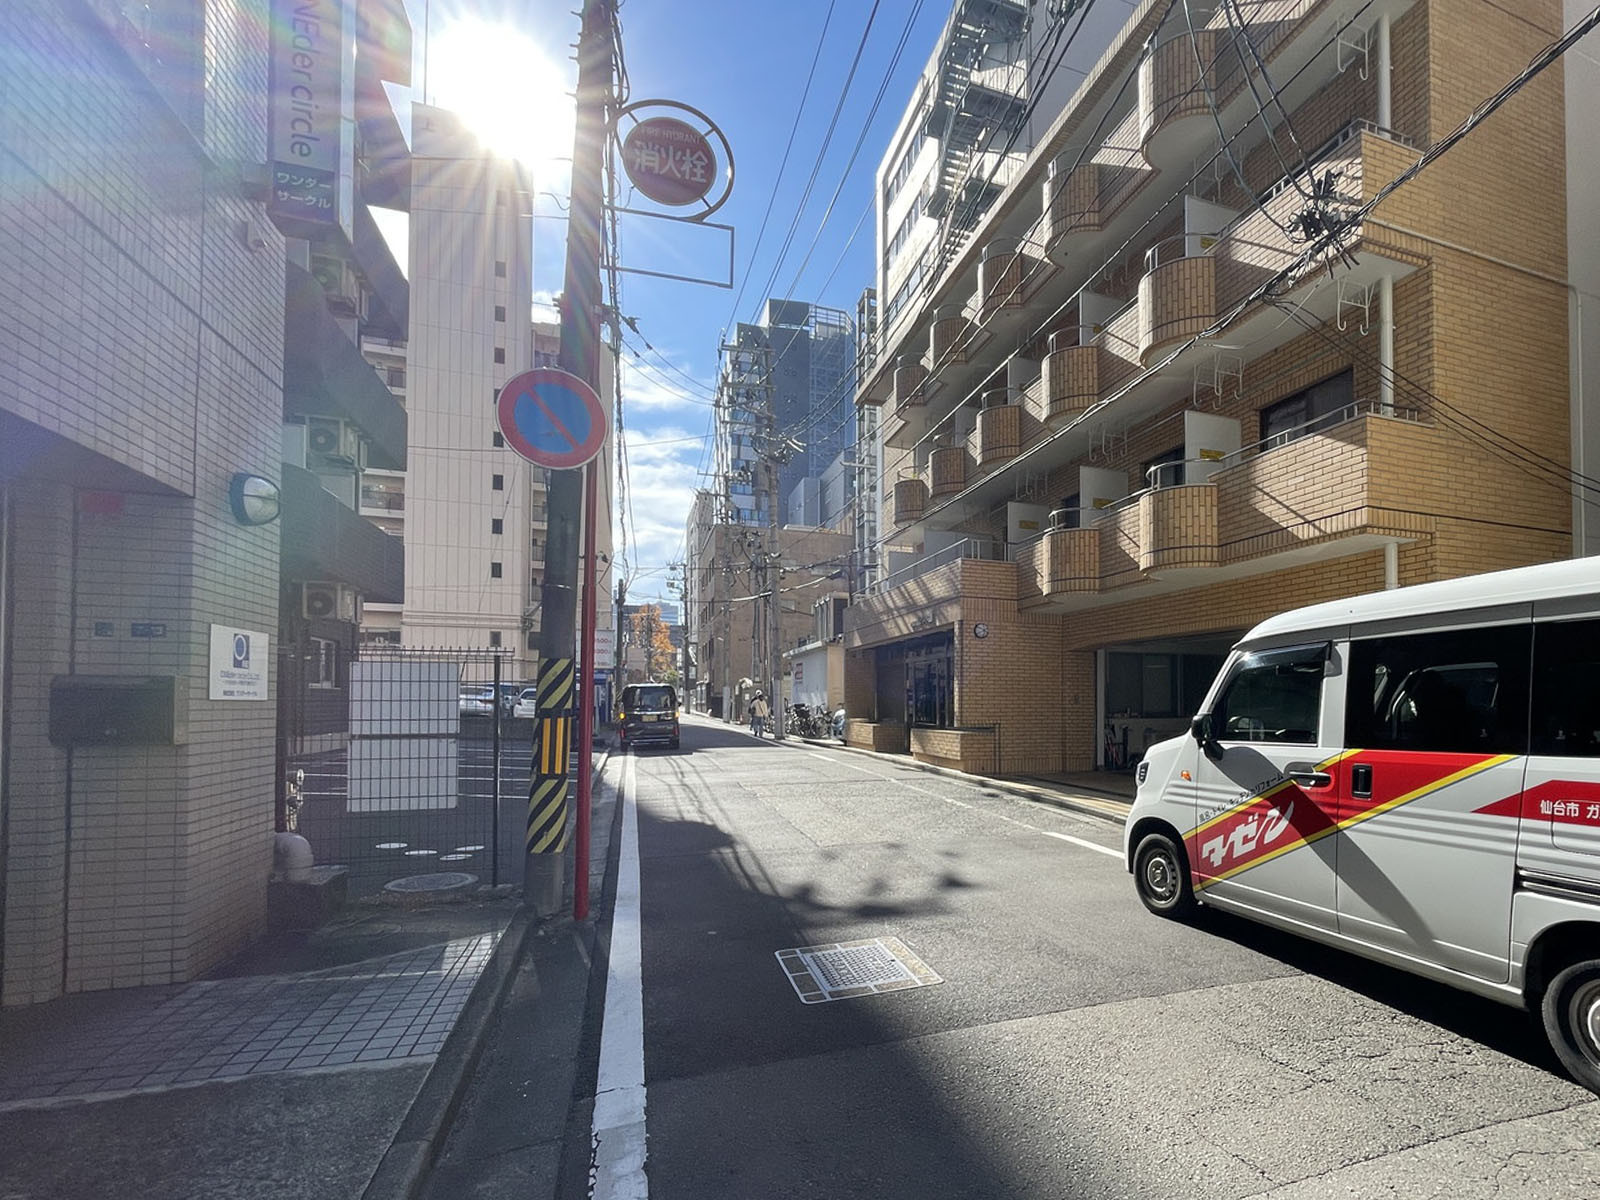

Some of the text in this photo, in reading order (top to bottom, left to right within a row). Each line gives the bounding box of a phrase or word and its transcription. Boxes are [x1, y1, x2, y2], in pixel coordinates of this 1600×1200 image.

[290, 85, 321, 157] circle
[662, 129, 701, 145] HYDRANT
[634, 140, 709, 183] 消火栓
[277, 190, 332, 209] サークル
[1540, 799, 1600, 820] 仙台市 ガ
